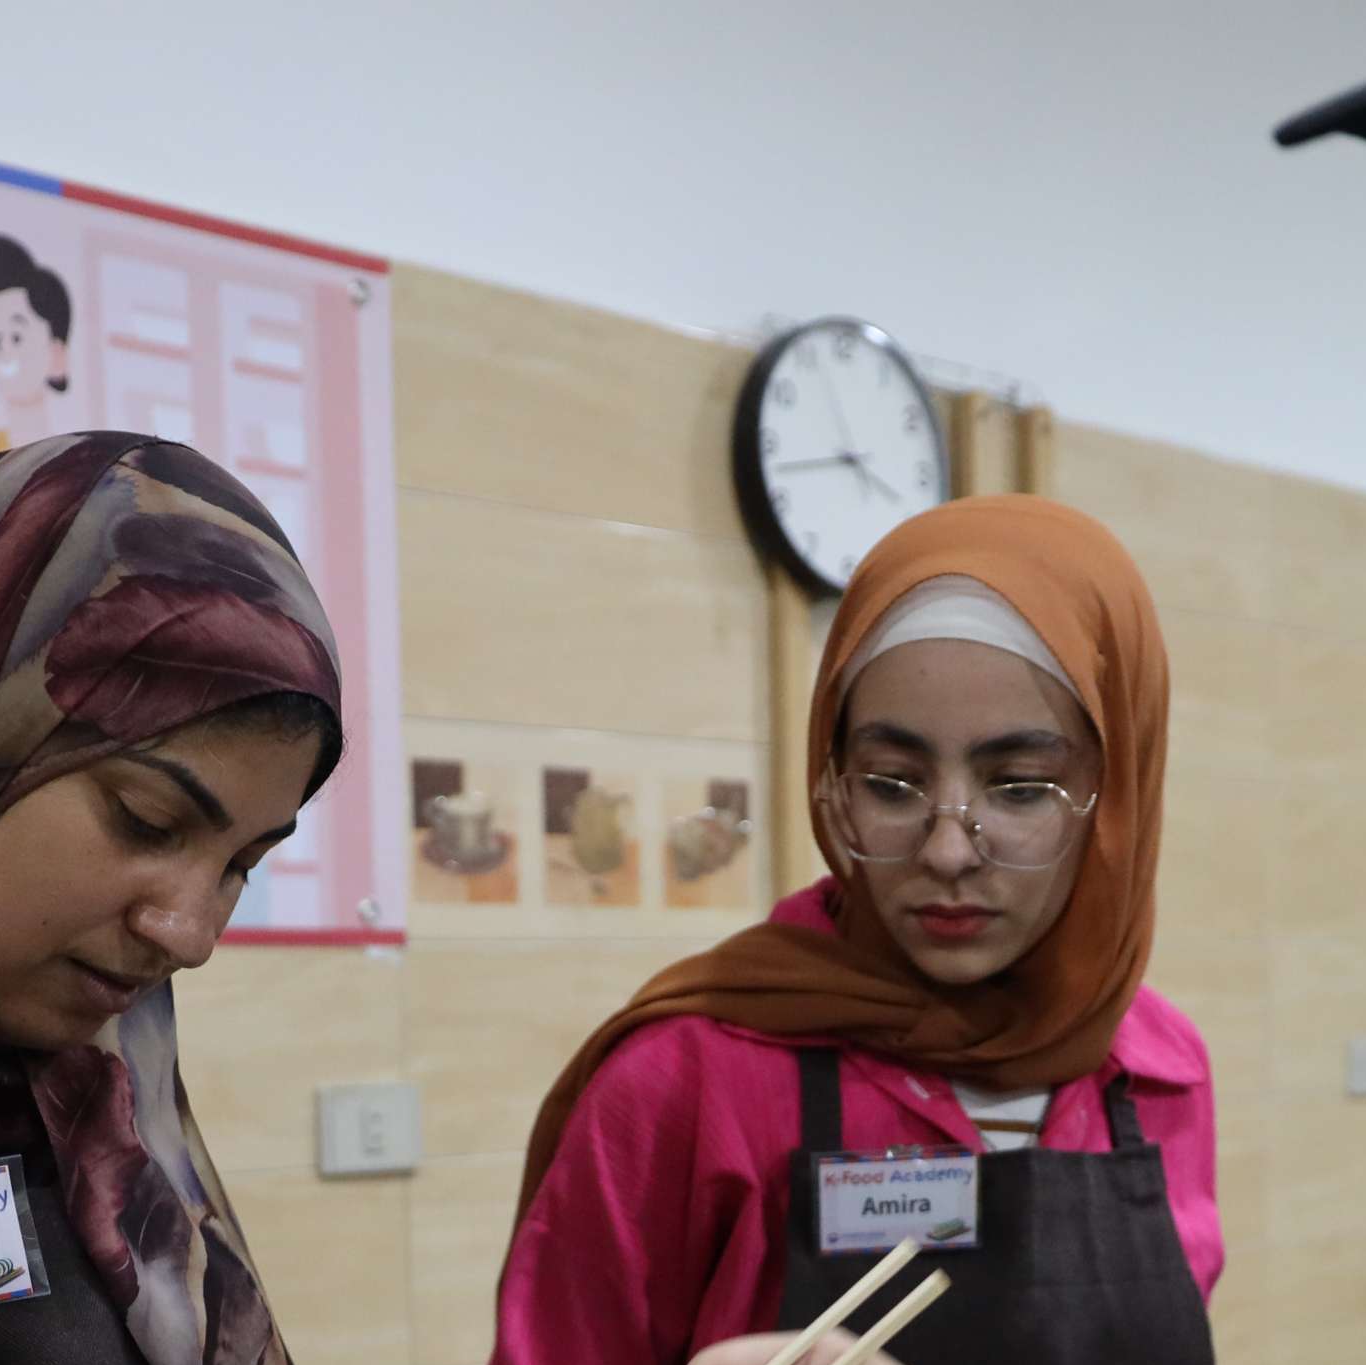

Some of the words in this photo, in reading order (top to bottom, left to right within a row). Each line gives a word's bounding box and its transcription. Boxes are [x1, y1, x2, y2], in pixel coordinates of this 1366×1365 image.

[825, 1170, 883, 1186] K-Food
[890, 1166, 973, 1184] Academy
[861, 1194, 931, 1216] Amira
